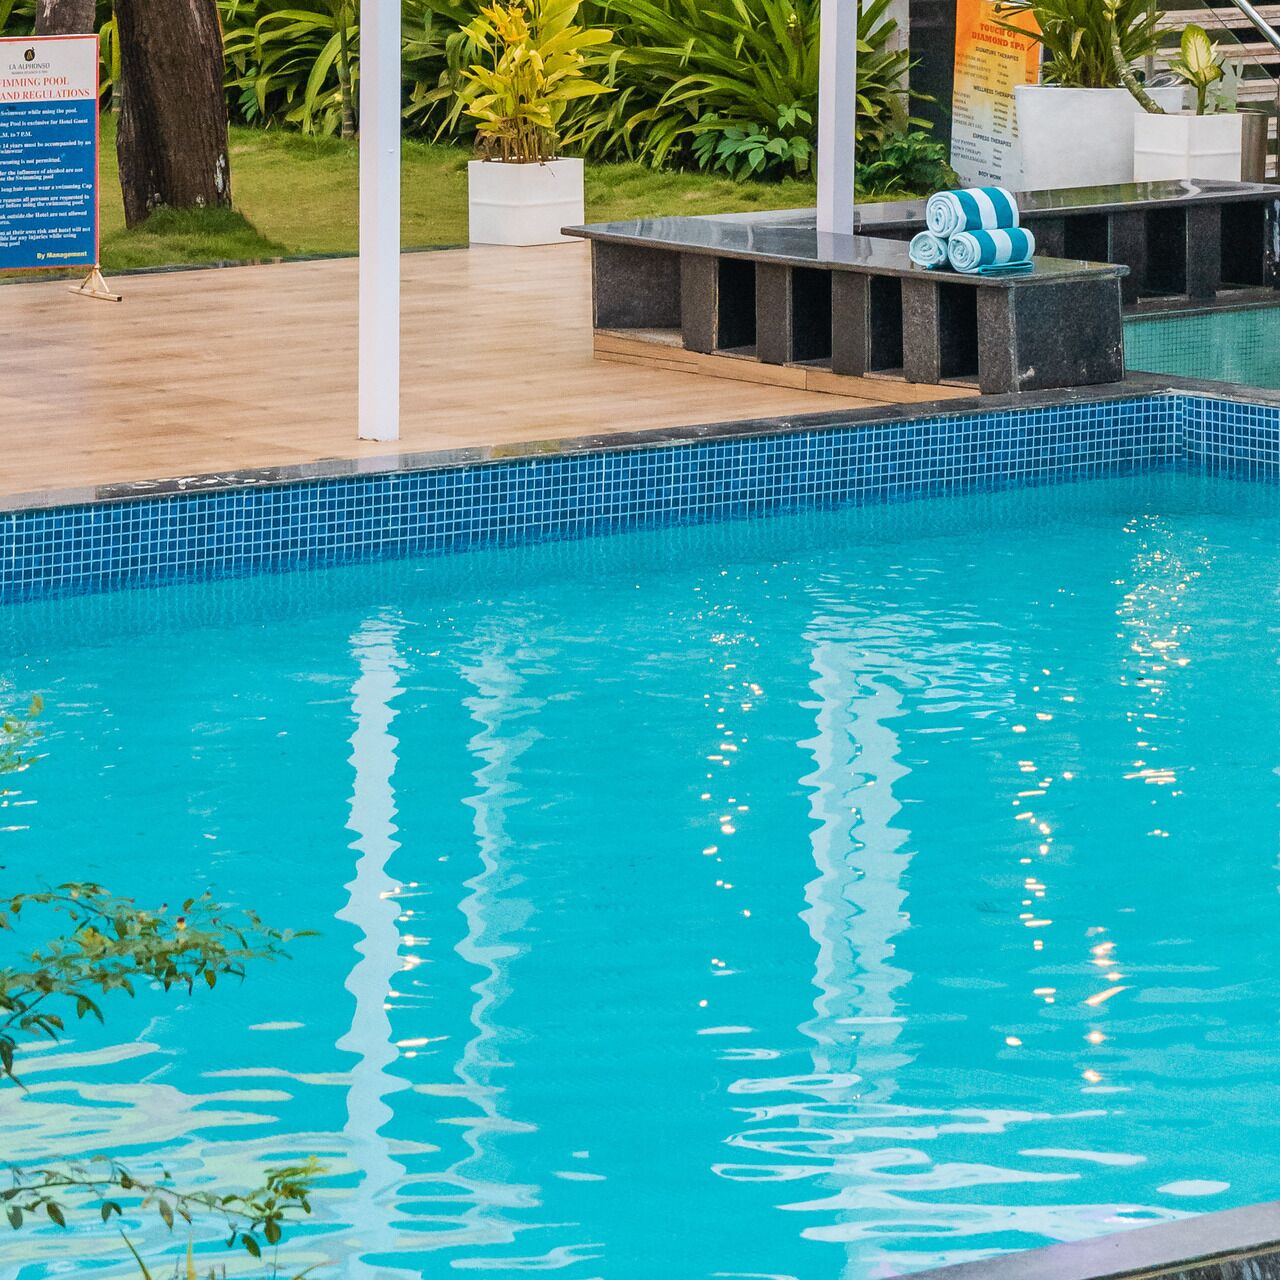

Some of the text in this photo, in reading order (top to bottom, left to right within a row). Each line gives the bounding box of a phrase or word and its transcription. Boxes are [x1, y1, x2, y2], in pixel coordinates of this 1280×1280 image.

[980, 23, 1005, 36] TOUCH
[972, 31, 1025, 51] DIAMOND SPA
[997, 52, 1019, 62] THERAPIES
[0, 76, 69, 87] IMMING POOL
[0, 88, 90, 100] AND REGULATIONS
[973, 85, 994, 95] WELLNESS
[47, 251, 88, 259] Management
